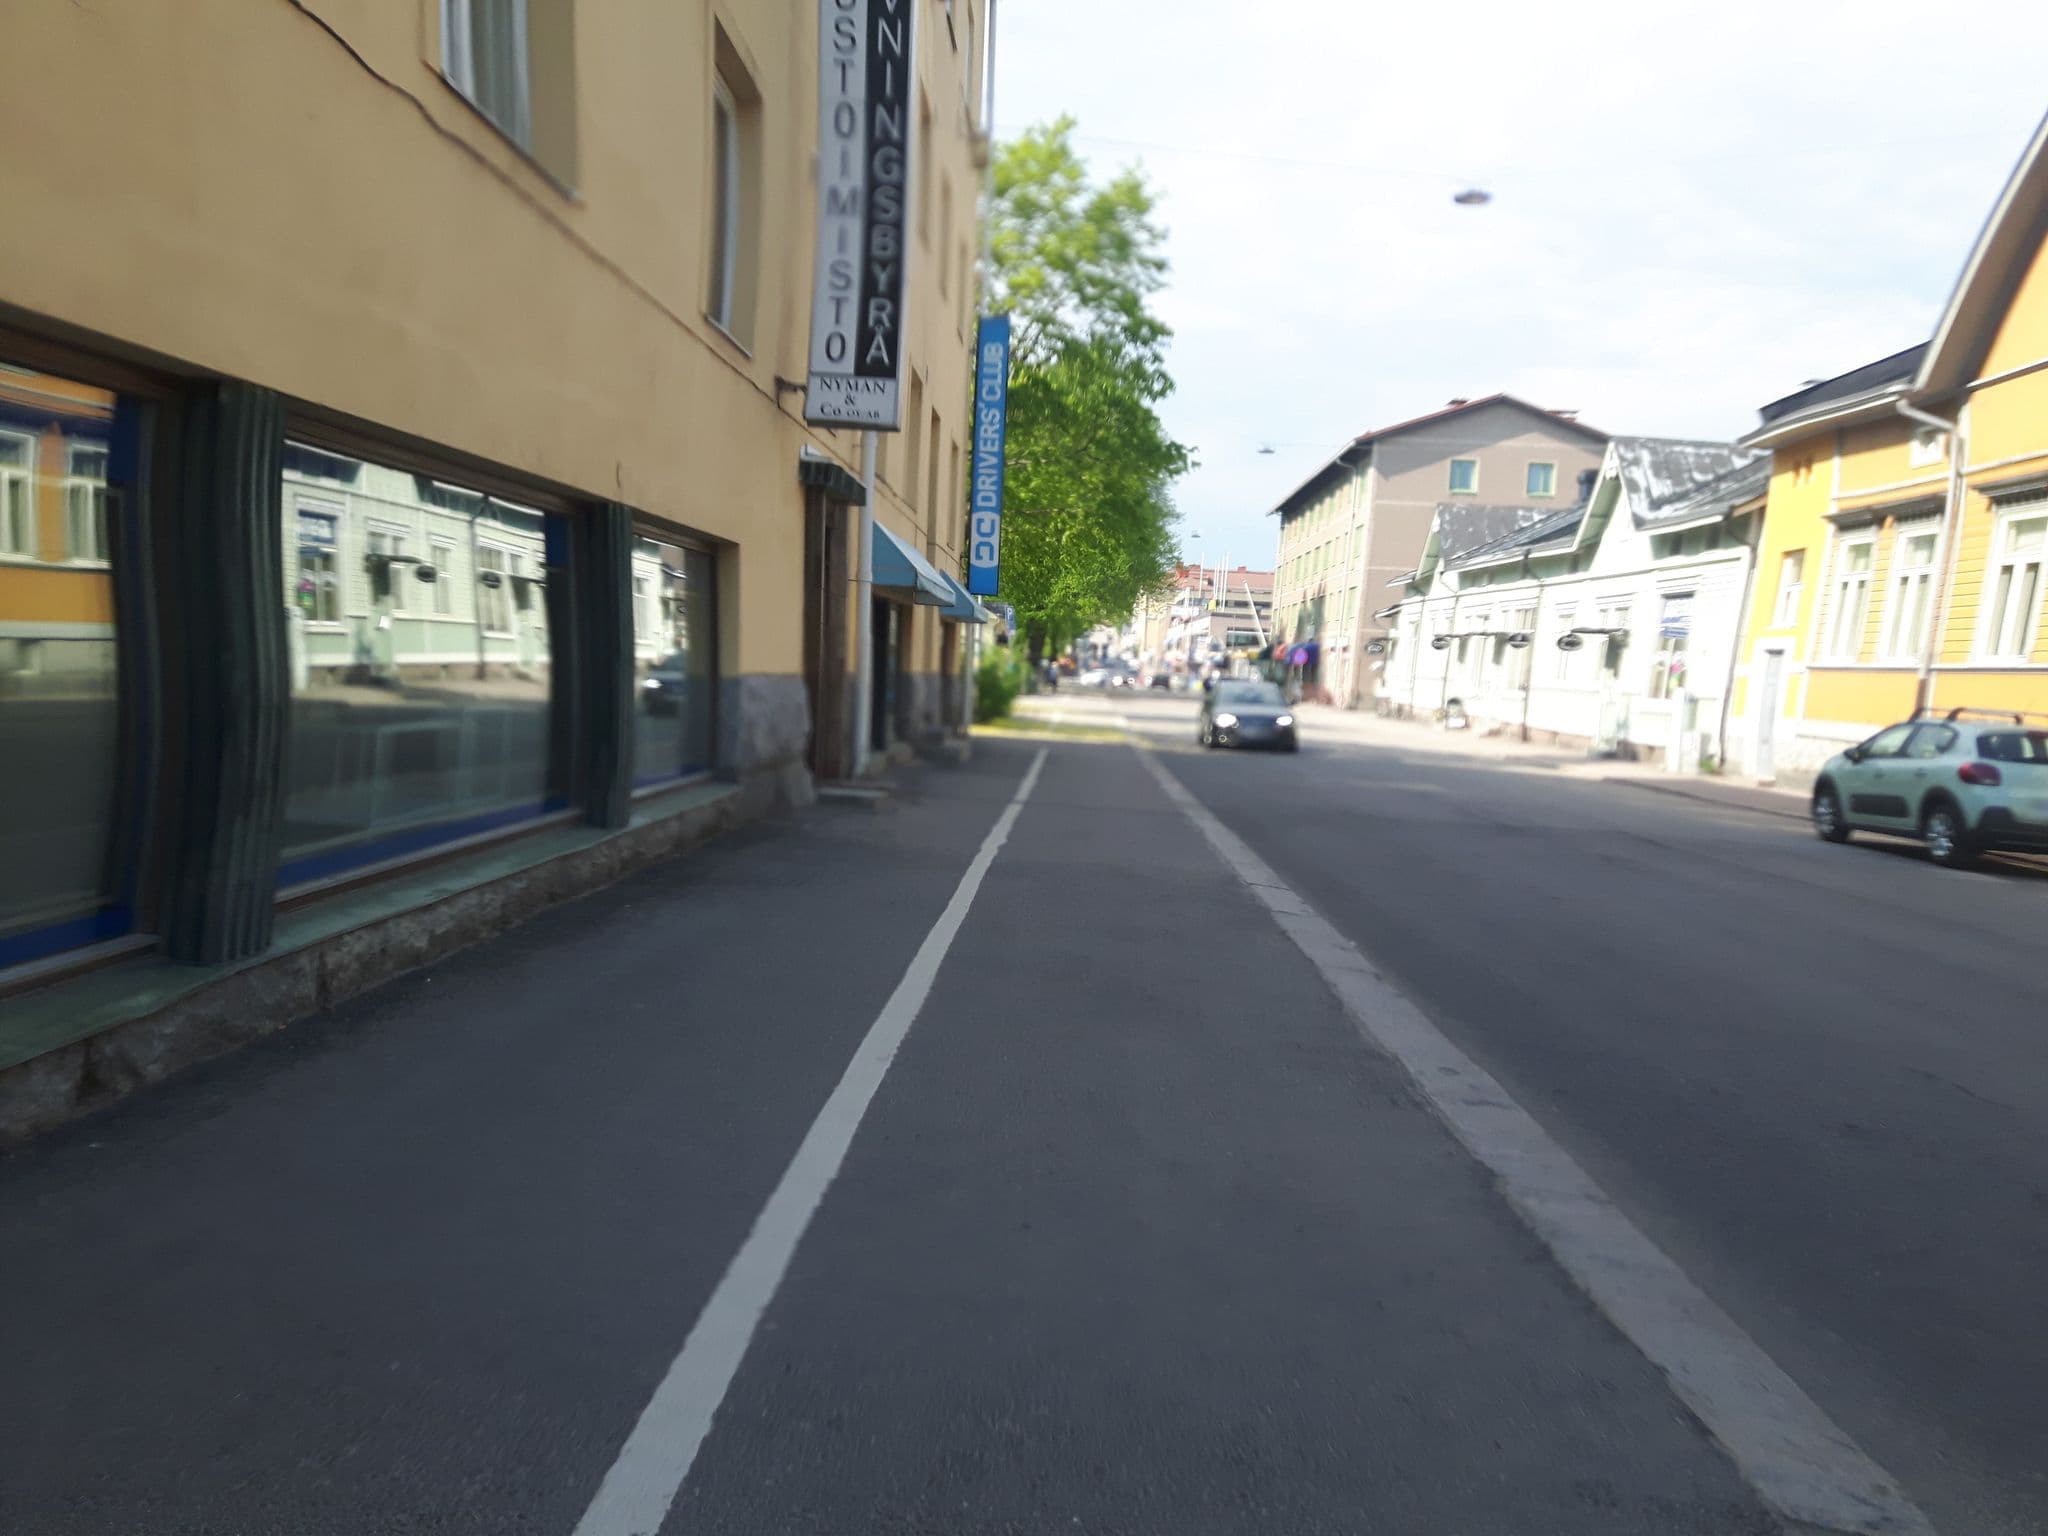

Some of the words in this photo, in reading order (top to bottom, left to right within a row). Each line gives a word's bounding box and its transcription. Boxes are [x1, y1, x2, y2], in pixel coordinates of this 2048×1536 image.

[825, 0, 858, 362] STOIMISTO
[820, 377, 886, 394] NYMAN
[981, 342, 1003, 400] CLUB
[844, 394, 856, 406] &
